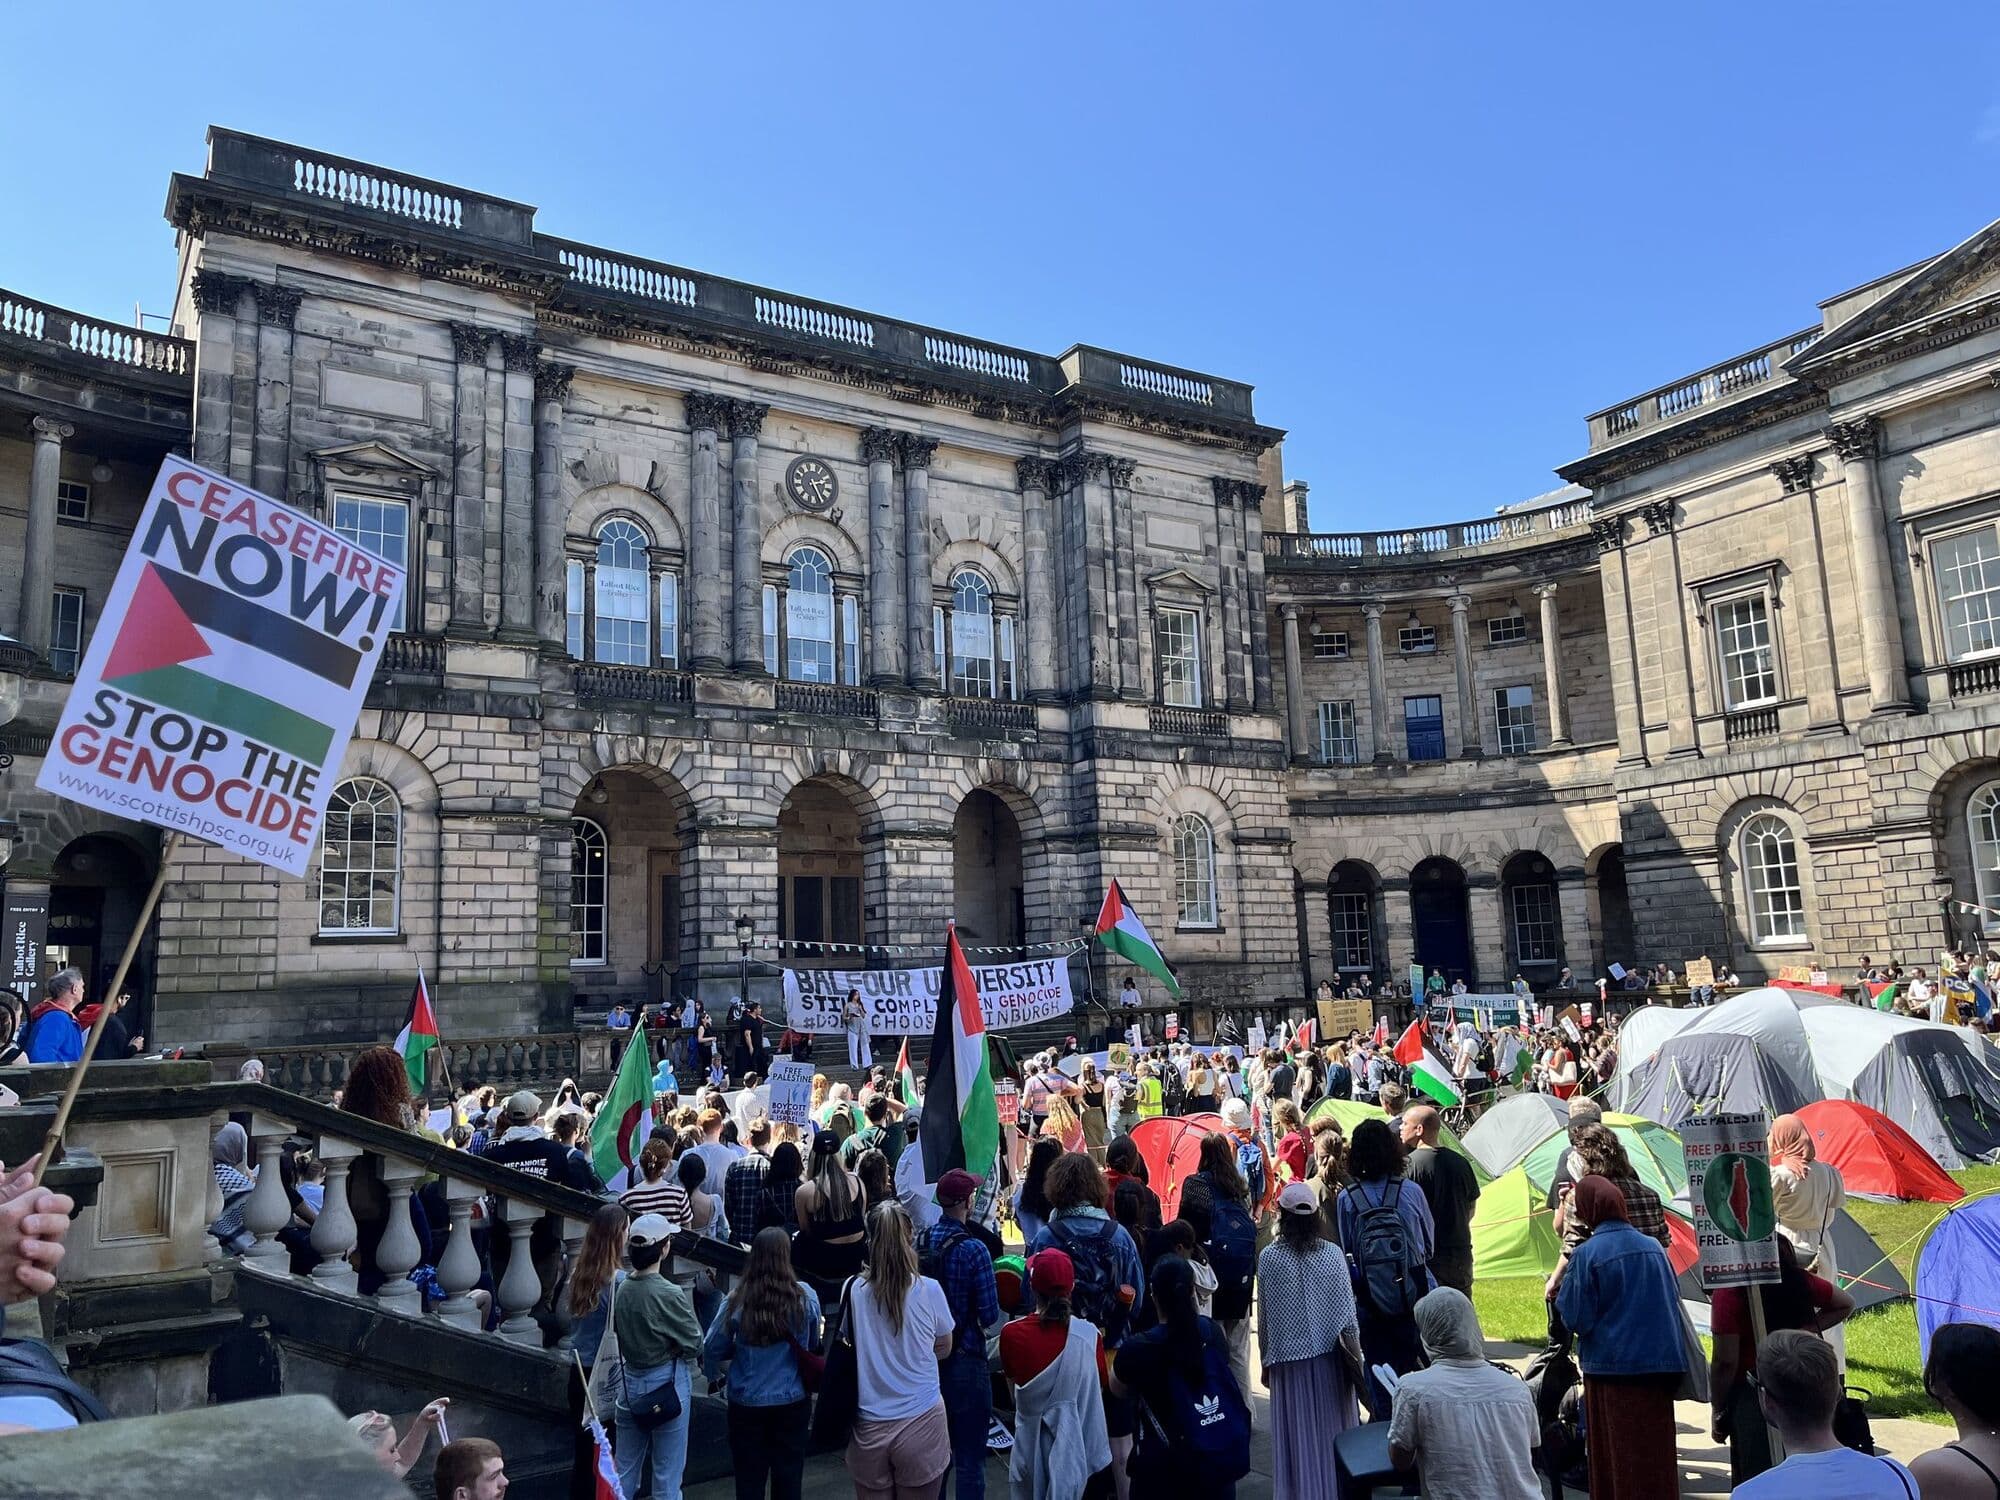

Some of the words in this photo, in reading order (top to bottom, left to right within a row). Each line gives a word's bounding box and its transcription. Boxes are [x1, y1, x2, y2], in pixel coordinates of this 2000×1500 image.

[168, 471, 396, 599] CEASEFIRE
[141, 498, 388, 653] NOW!
[84, 689, 228, 762] STOP
[241, 741, 321, 805] THE
[60, 723, 318, 844] GENOCIDE
[57, 770, 295, 864] www.scottishpsc.org.uk
[16, 921, 26, 944] Rice
[14, 945, 25, 978] Talbot
[25, 940, 38, 977] Gallery
[794, 970, 912, 996] BALFOUR
[922, 961, 1055, 996] UVERSITY
[1945, 977, 1970, 991] PCS
[802, 995, 846, 1013] STI
[875, 998, 941, 1014] COMPL
[999, 986, 1061, 1008] GENOCIDE
[871, 1014, 934, 1030] CHOOS
[985, 1001, 1060, 1026] INBURGH
[773, 1073, 813, 1083] PALESTINE
[784, 1067, 803, 1075] FREE
[772, 1102, 806, 1111] BOYCOTT
[776, 1115, 798, 1123] ISRAEL
[1678, 1117, 1709, 1128] FREE
[1685, 1143, 1712, 1156] FREE
[504, 1158, 548, 1168] MECANIQUE
[1687, 1158, 1711, 1171] FRE
[1703, 1263, 1735, 1275] FREE
[1736, 1261, 1778, 1271] PALES
[1200, 1412, 1226, 1426] adidas
